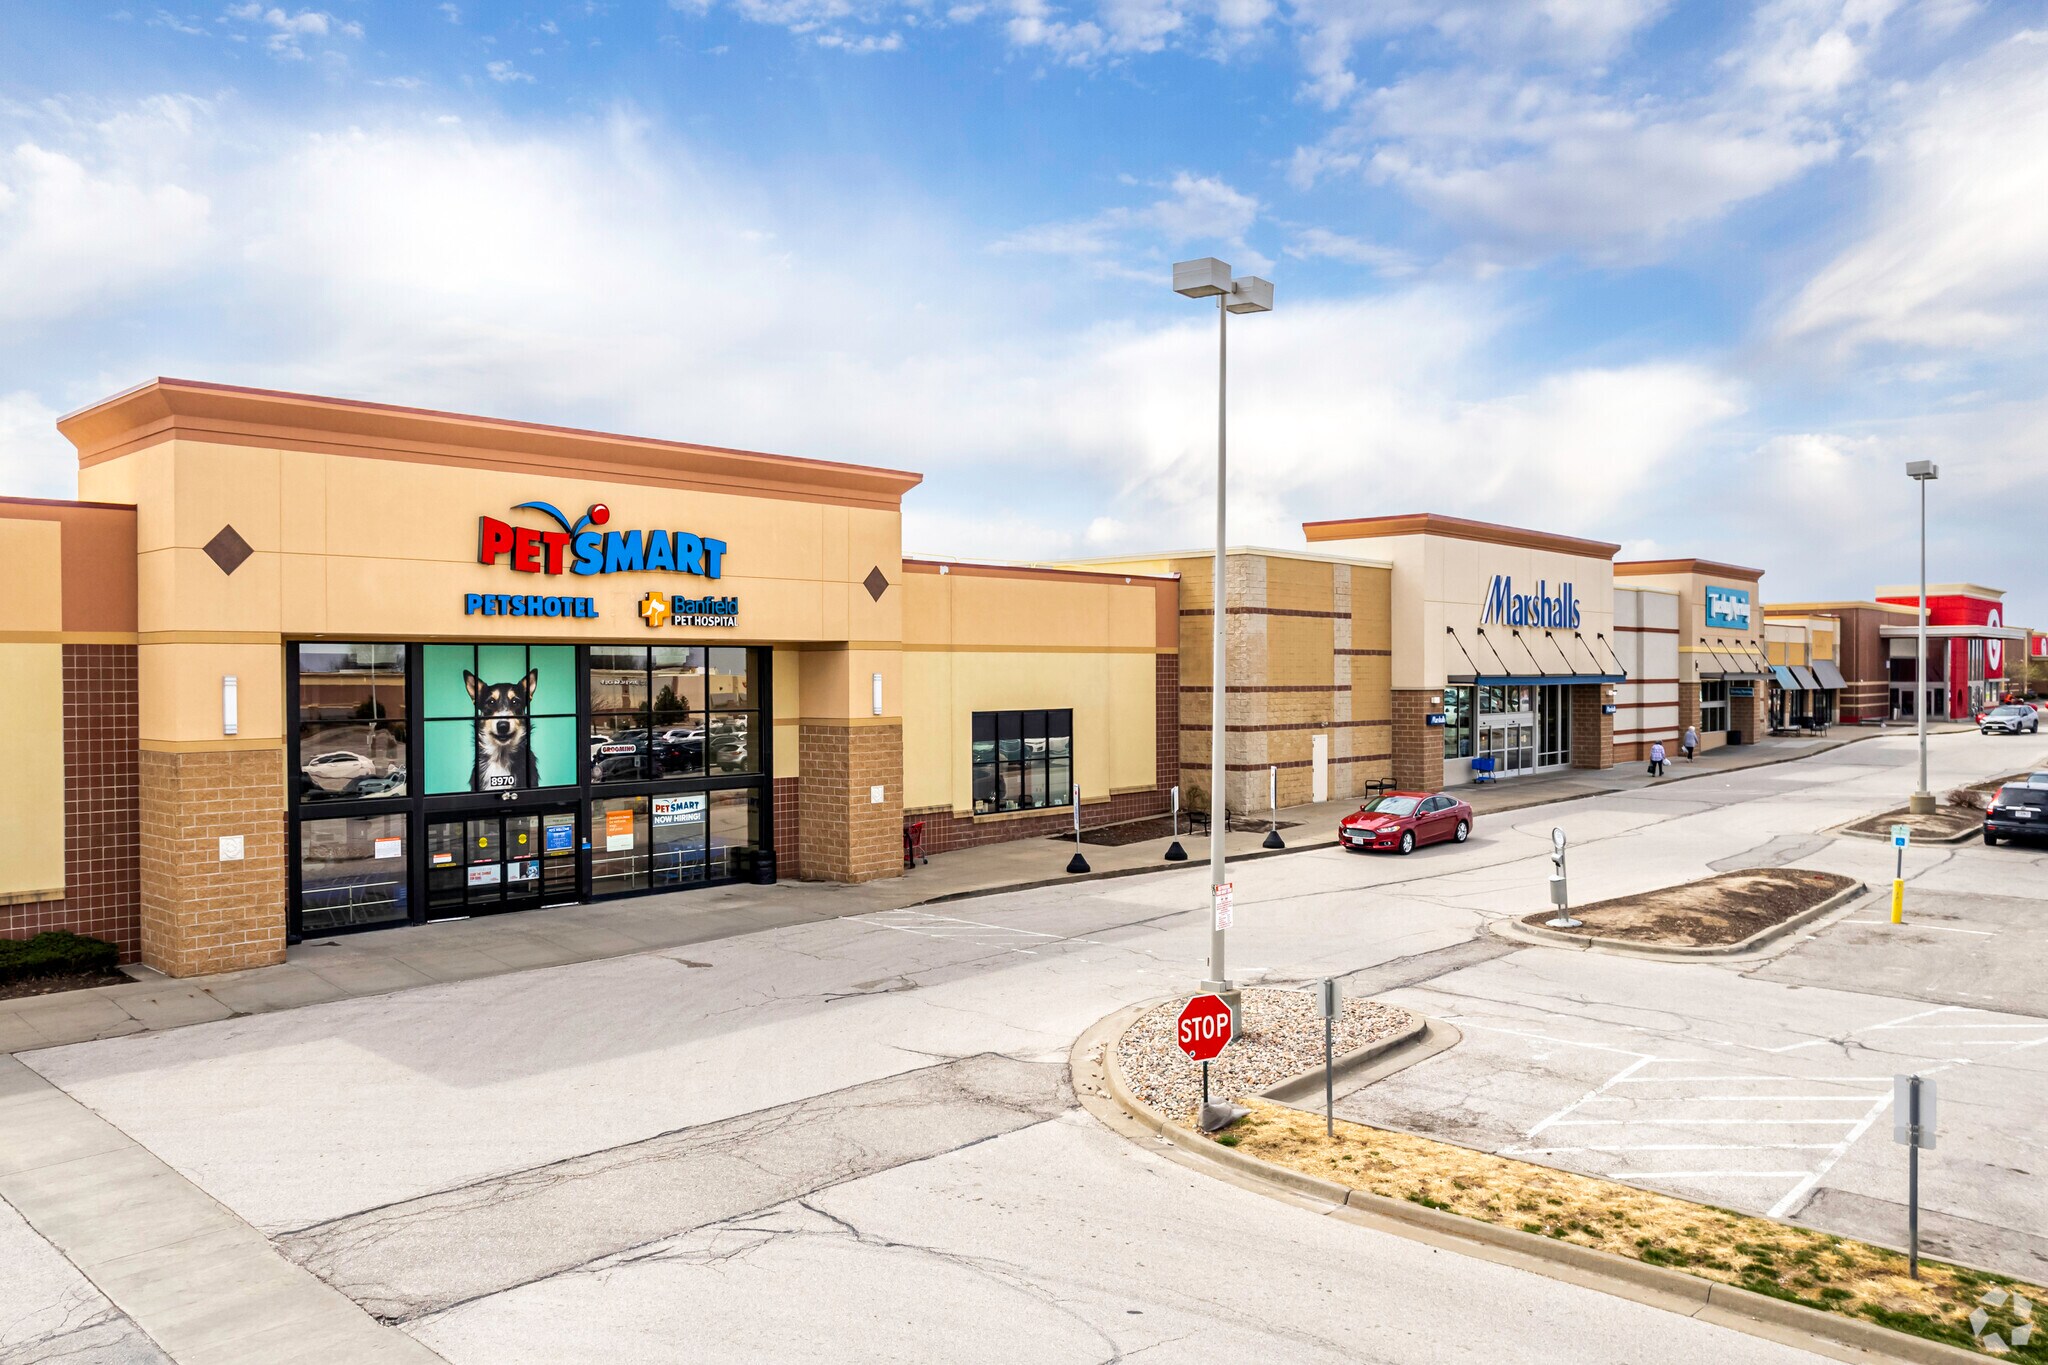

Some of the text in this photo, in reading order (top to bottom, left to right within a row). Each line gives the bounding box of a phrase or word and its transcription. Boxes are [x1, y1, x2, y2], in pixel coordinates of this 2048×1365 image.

[478, 514, 727, 579] PETSMART
[464, 593, 599, 618] PETSHOTEL
[671, 594, 739, 615] Banfield
[1480, 574, 1580, 629] Marshalls
[671, 615, 738, 627] PET HOSPITAL
[602, 745, 635, 753] GROOMING
[491, 776, 515, 786] 8970
[655, 801, 699, 813] PETSMART
[654, 813, 701, 824] NOW HIRING!
[1180, 1013, 1229, 1043] STOP
